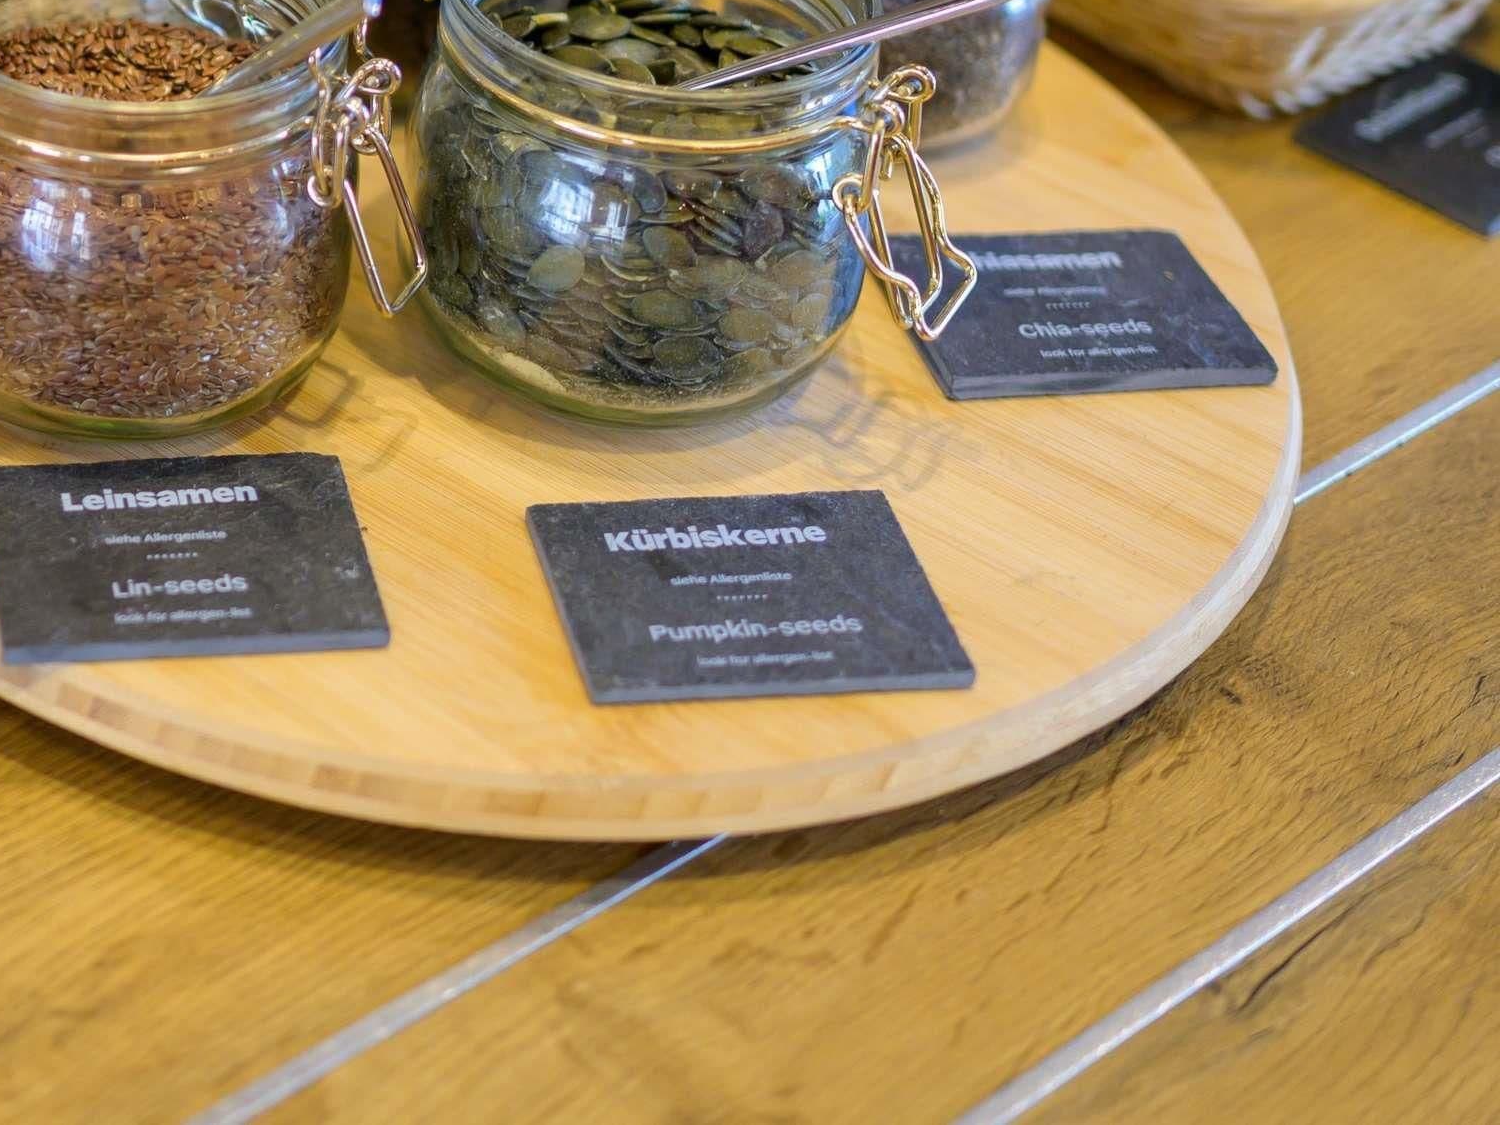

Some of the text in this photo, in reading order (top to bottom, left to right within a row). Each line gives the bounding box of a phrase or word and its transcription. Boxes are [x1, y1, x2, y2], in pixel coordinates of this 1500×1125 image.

[968, 251, 1124, 271] hiasamen
[1018, 318, 1153, 338] Chia-seeds
[60, 485, 258, 512] Leinsamen
[144, 529, 228, 543] Allergenliste
[603, 524, 827, 552] Kürbiskerne
[111, 573, 249, 599] Lin-seeds
[649, 615, 863, 643] Pumpkin-seeds
